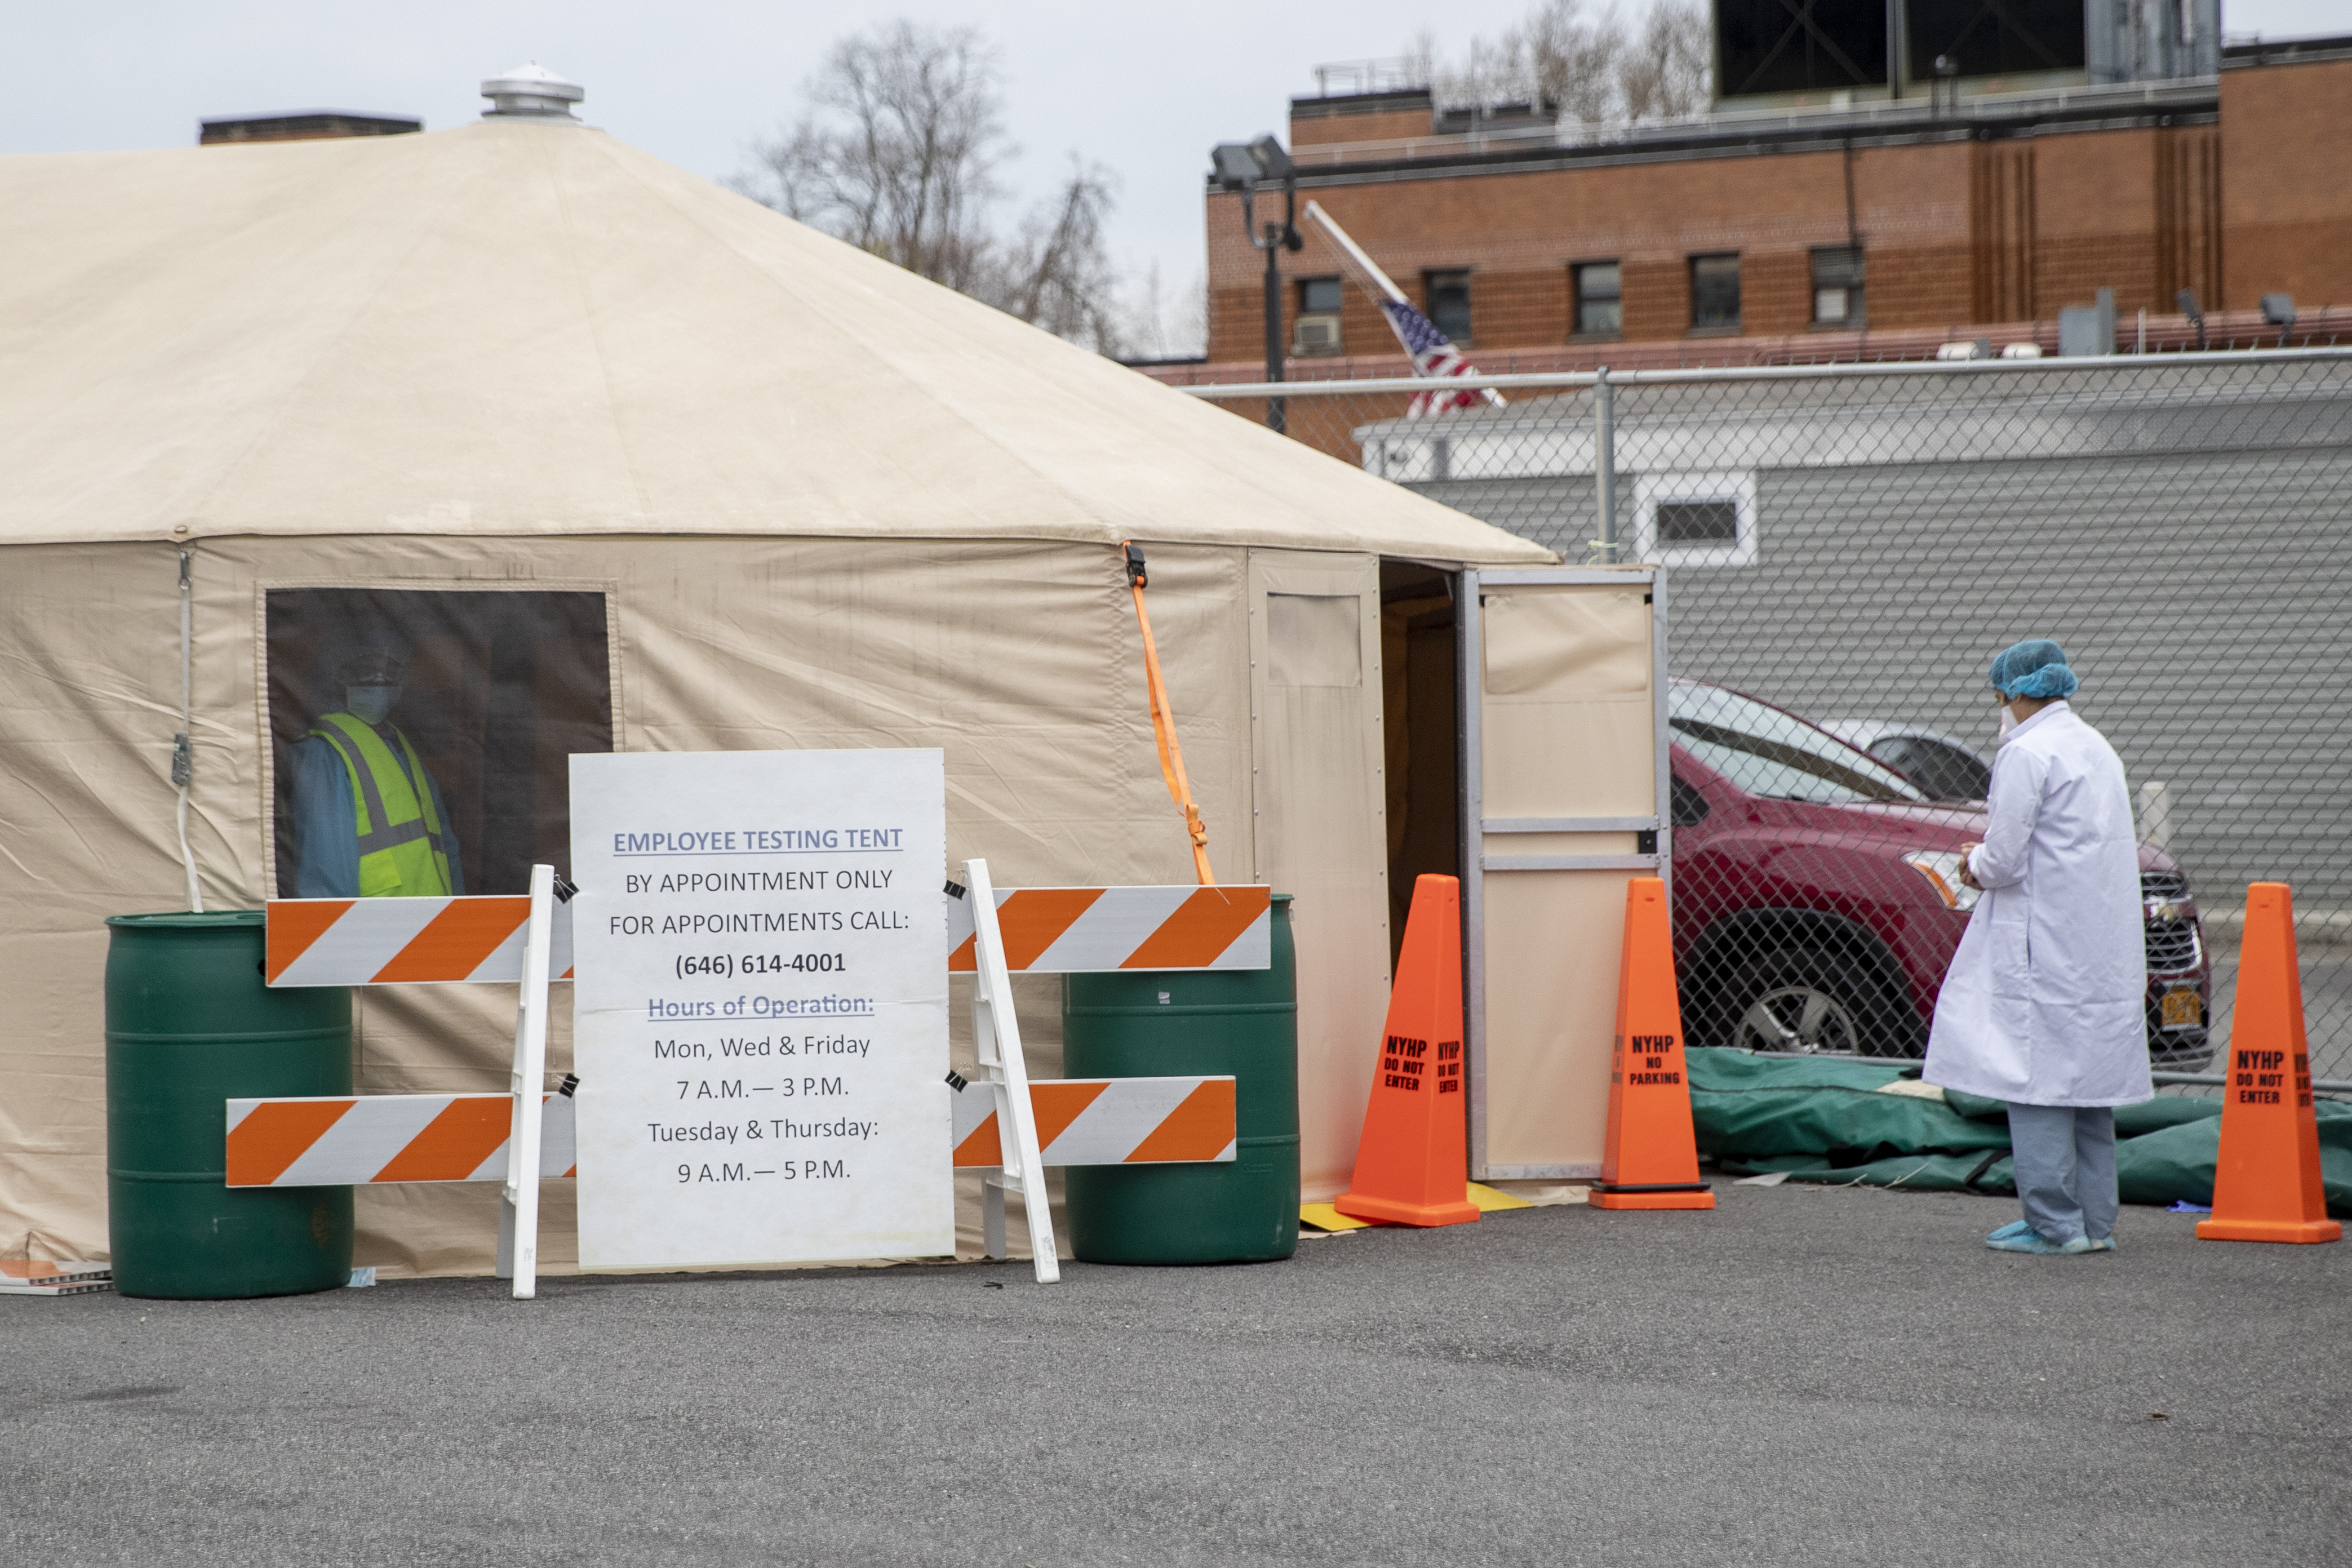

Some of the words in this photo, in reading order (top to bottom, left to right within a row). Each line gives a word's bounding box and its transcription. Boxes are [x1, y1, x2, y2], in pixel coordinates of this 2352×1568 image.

[614, 832, 736, 852] EMPLOYEE
[743, 830, 837, 850] TESTING
[845, 829, 903, 847] TENT
[627, 874, 652, 893] BY
[660, 871, 828, 892] APPOINTMENT
[836, 870, 893, 889] ONLY
[611, 916, 654, 935] FOR
[662, 912, 843, 934] APPOINTMENTS
[850, 911, 908, 930] CALL:
[676, 954, 733, 980] (646)
[742, 953, 846, 974] 614-4001
[649, 998, 715, 1017] Hours
[723, 995, 746, 1015] of
[753, 994, 874, 1018] Operation:
[655, 1040, 712, 1060] Mon,
[720, 1036, 770, 1056] Wed
[779, 1036, 796, 1055] &
[805, 1034, 870, 1058] Friday
[1387, 1036, 1427, 1058] NYHP
[1632, 1036, 1674, 1052] NYHP
[1384, 1058, 1399, 1071] DO
[1403, 1060, 1424, 1074] NOT
[1647, 1057, 1661, 1068] NO
[2238, 1050, 2283, 1069] NYHP
[677, 1081, 689, 1099] 7
[783, 1078, 795, 1096] 3
[804, 1077, 848, 1096] P.M.
[1385, 1074, 1419, 1091] ENTER
[1630, 1072, 1680, 1085] PARKING
[2236, 1074, 2252, 1086] DO
[2259, 1074, 2283, 1087] NOT
[2240, 1091, 2279, 1104] ENTER
[647, 1121, 738, 1144] Tuesday
[747, 1120, 763, 1139] &
[770, 1117, 878, 1140] Thursday:
[678, 1164, 690, 1183] 9
[785, 1161, 796, 1180] 5
[805, 1160, 850, 1179] P.M.
